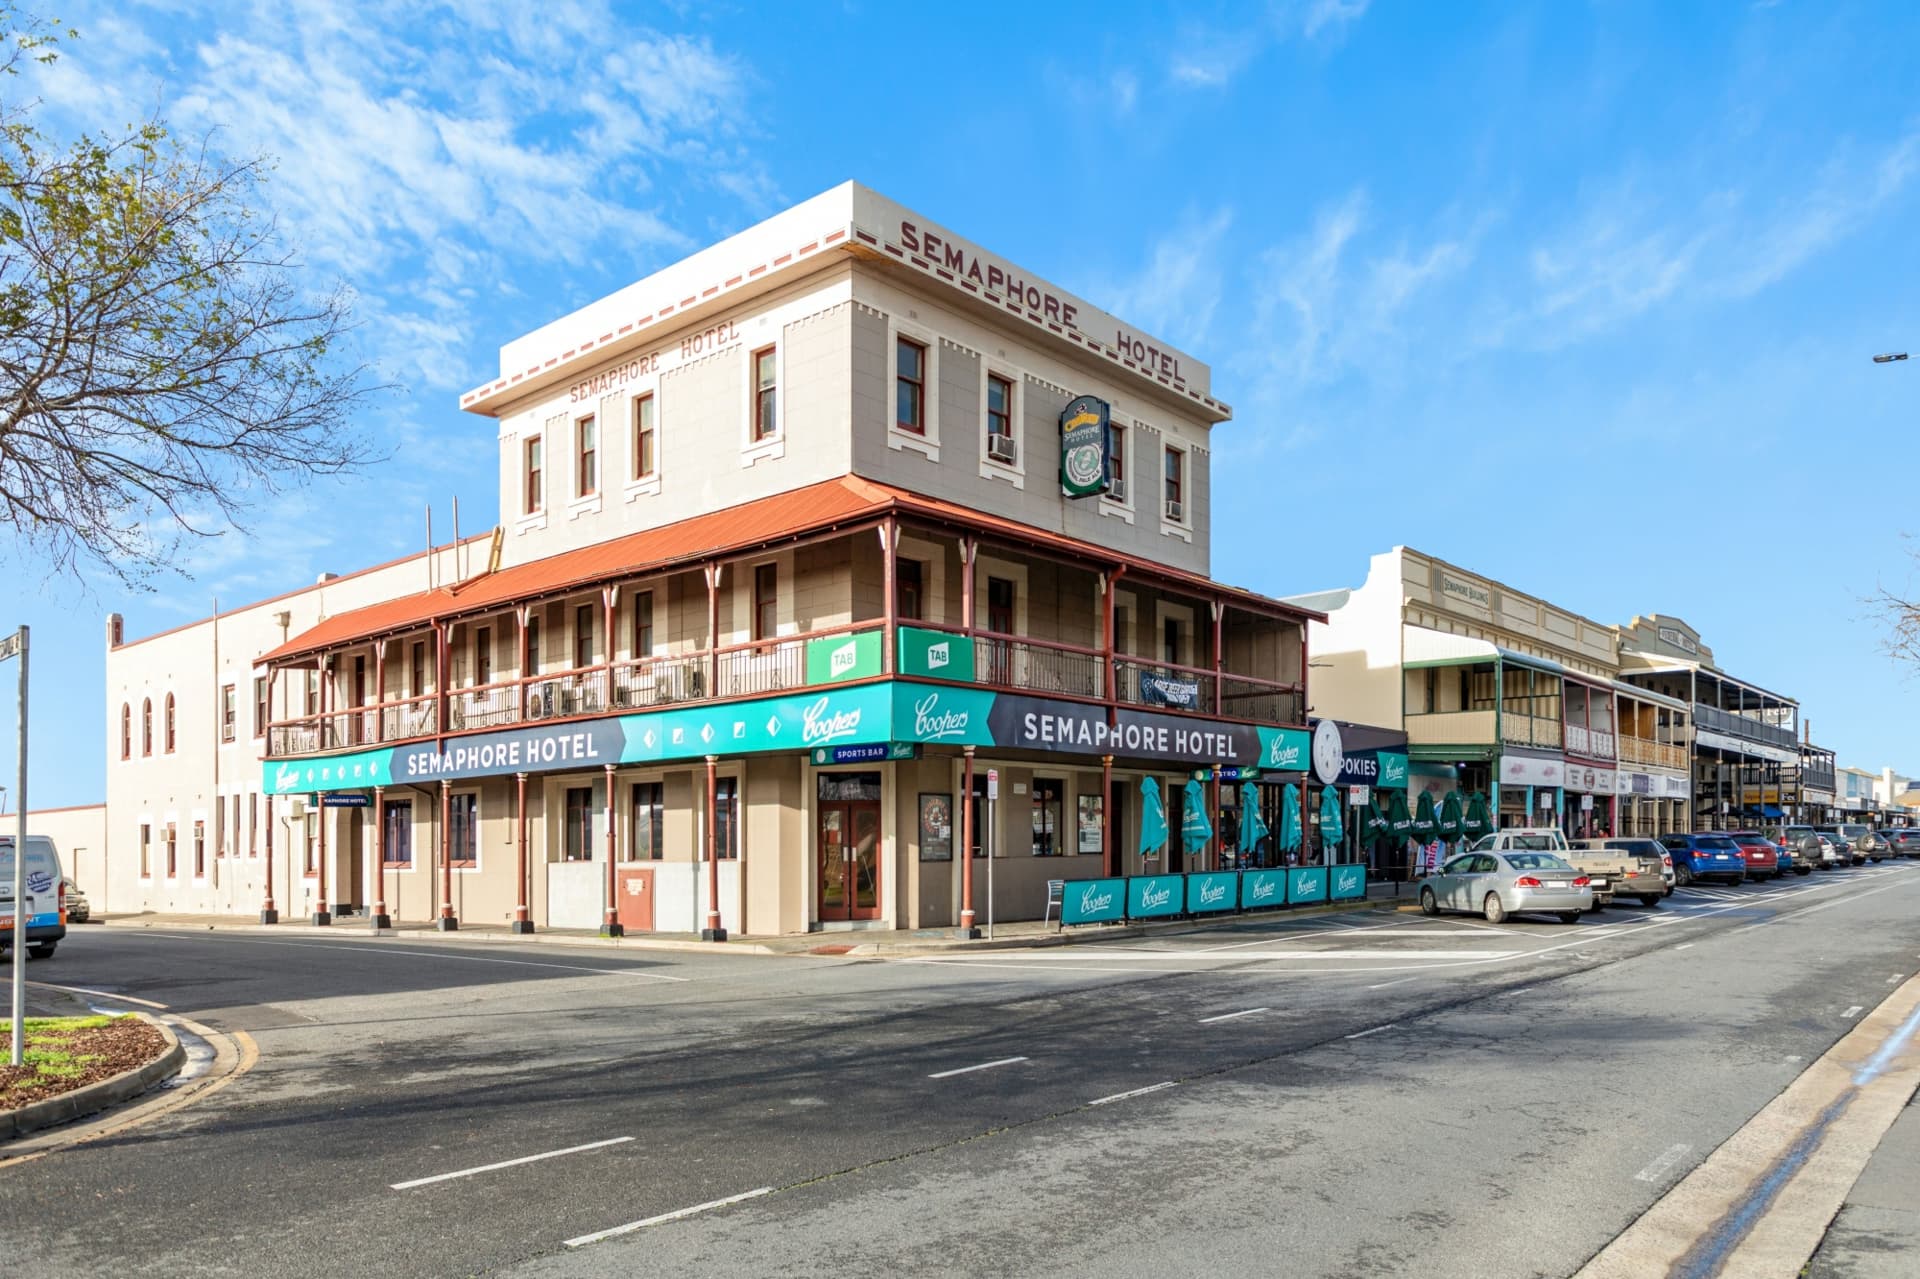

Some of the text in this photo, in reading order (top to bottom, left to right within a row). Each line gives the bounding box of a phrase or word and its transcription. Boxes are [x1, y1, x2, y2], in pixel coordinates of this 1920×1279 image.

[901, 221, 1186, 383] SEMAPHORE HOTEL
[570, 320, 740, 403] SEMAPHORE HOTEL
[1063, 425, 1100, 441] SEMAPHORE
[834, 654, 853, 666] TAB
[930, 650, 947, 662] TAB
[803, 697, 861, 746] Coopers
[915, 693, 968, 740] Coopers
[1024, 713, 1237, 758] SEMAPHORE HOTEL
[1271, 733, 1299, 765] Coopers
[408, 733, 598, 776] SEMAPHORE HOTEL
[837, 750, 865, 759] SPORTS
[868, 748, 884, 756] BAR
[1339, 757, 1377, 776] POKIES
[1081, 884, 1112, 915] Coopers
[1142, 880, 1170, 909] Coopers
[1201, 877, 1225, 904] Coopers
